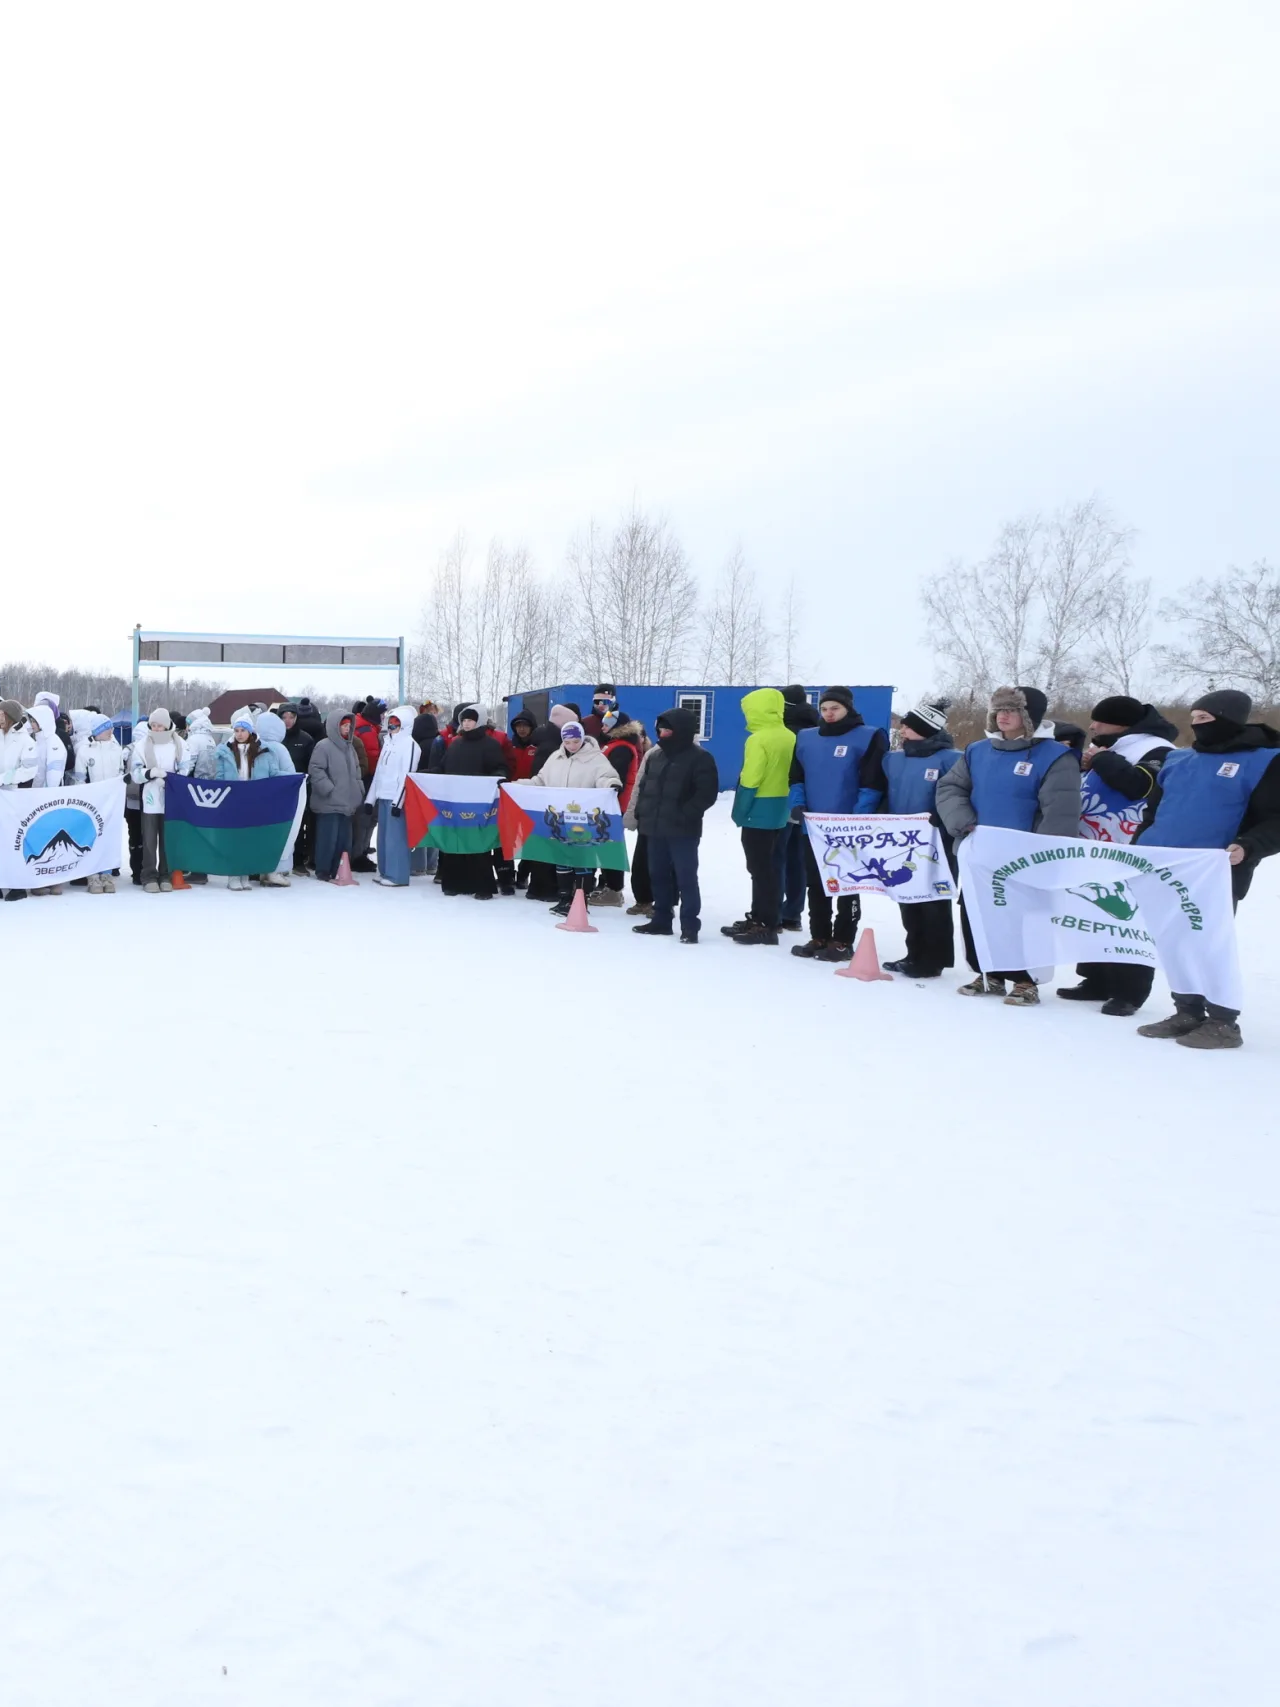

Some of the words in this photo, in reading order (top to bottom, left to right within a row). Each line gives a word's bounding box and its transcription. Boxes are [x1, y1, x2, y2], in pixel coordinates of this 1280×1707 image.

[21, 798, 65, 828] физического
[34, 861, 79, 876] ЭВЕРЕСТ
[1030, 846, 1086, 865] ШКОЛА
[1168, 880, 1203, 931] РЕЗЕРВА
[1114, 946, 1156, 960] МИАСС
